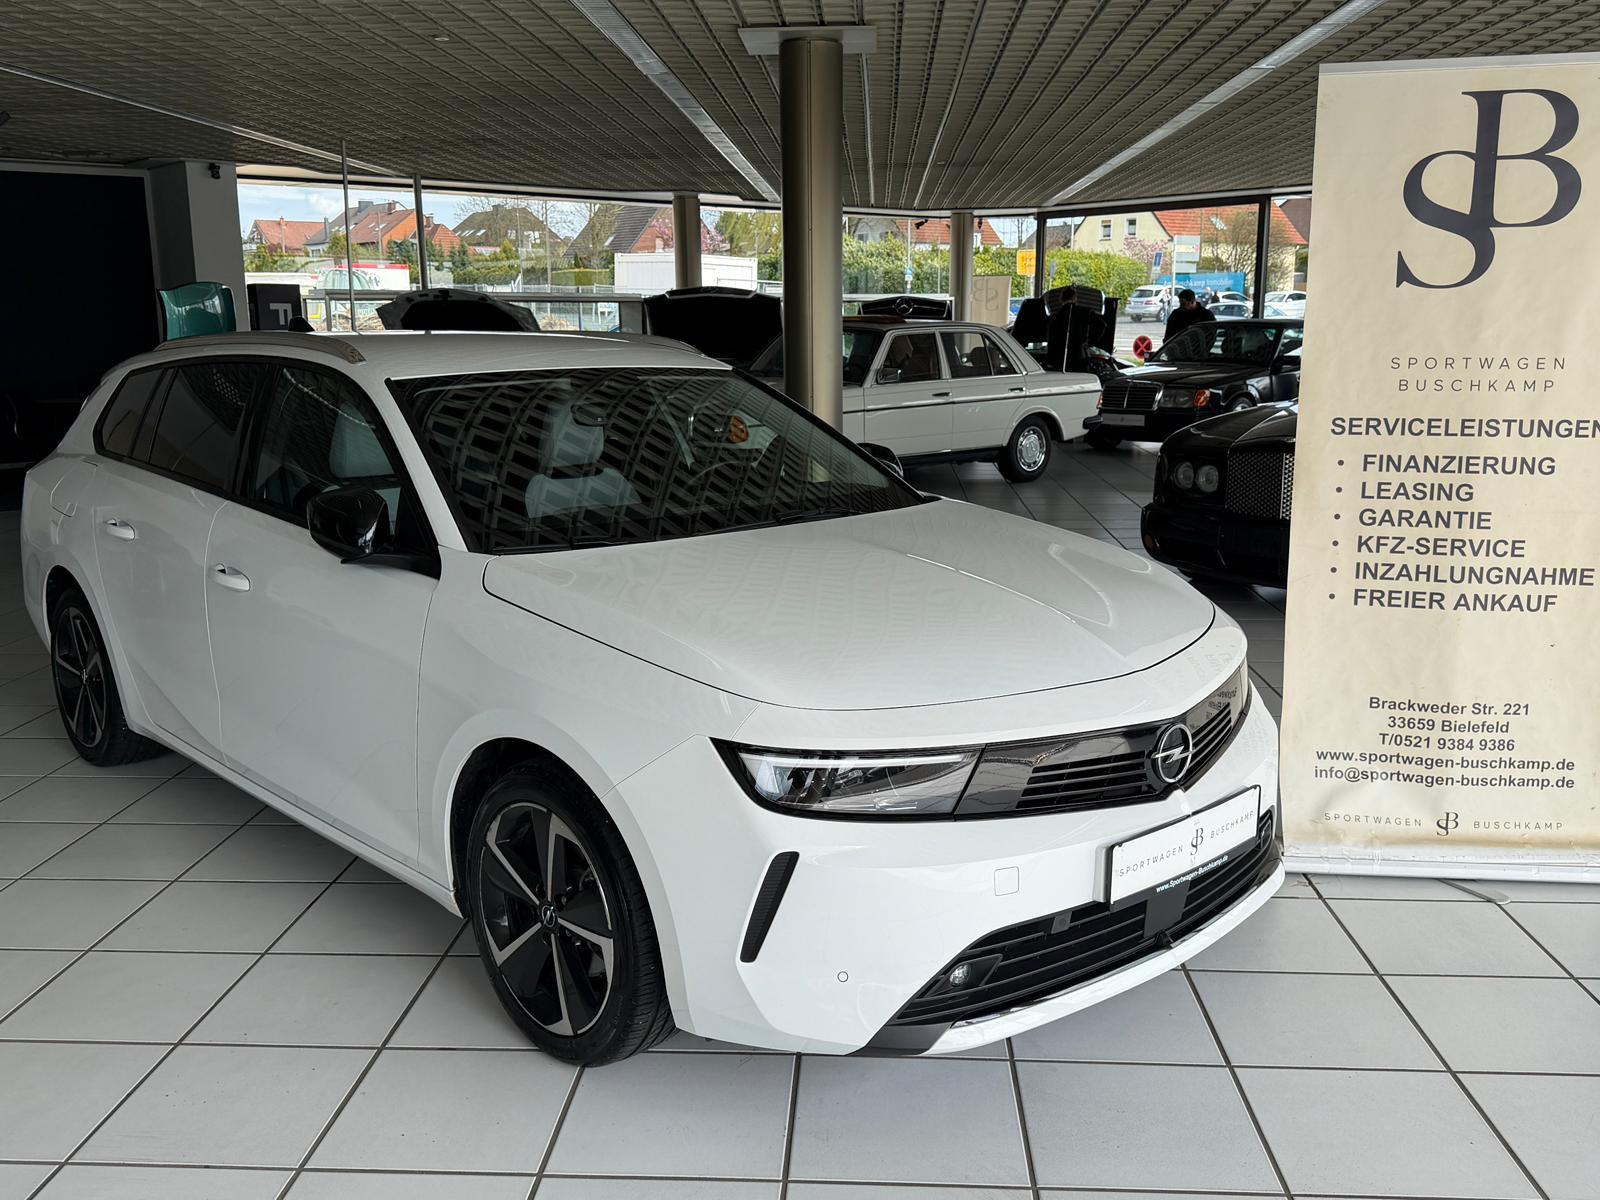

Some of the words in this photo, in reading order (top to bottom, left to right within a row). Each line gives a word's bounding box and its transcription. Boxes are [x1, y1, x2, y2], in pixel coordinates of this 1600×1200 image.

[1391, 356, 1566, 370] SPORTWAGEN
[1399, 379, 1555, 392] BUSCHKAMP
[1362, 453, 1556, 475] FINANZIERUNG
[1361, 481, 1474, 502] LEASING
[1358, 508, 1492, 530] GARANTIE
[1357, 535, 1526, 558] KFZ-SERVICE
[1355, 561, 1595, 586] INZAHLUNGNAHME
[1353, 588, 1445, 610] FREIER
[1453, 593, 1558, 613] ANKAUF
[1369, 697, 1467, 715] Brackweder
[1471, 702, 1498, 716] Str.
[1503, 703, 1529, 716] 221
[1388, 716, 1435, 731] 33659
[1441, 720, 1510, 734] Bielefeld
[1379, 733, 1431, 749] T/0521
[1437, 737, 1474, 751] 9384
[1479, 738, 1515, 752] 9386
[1316, 750, 1575, 771] www.sportwagen-buschkamp.de
[1314, 767, 1575, 790] info@sportwagen-buschkamp.de
[1324, 812, 1423, 827] SPORTWAGEN
[1473, 820, 1564, 831] BUSCHKAMP
[1119, 845, 1183, 877] SPORTWAGEN
[1210, 810, 1254, 839] BUSCHKAMP
